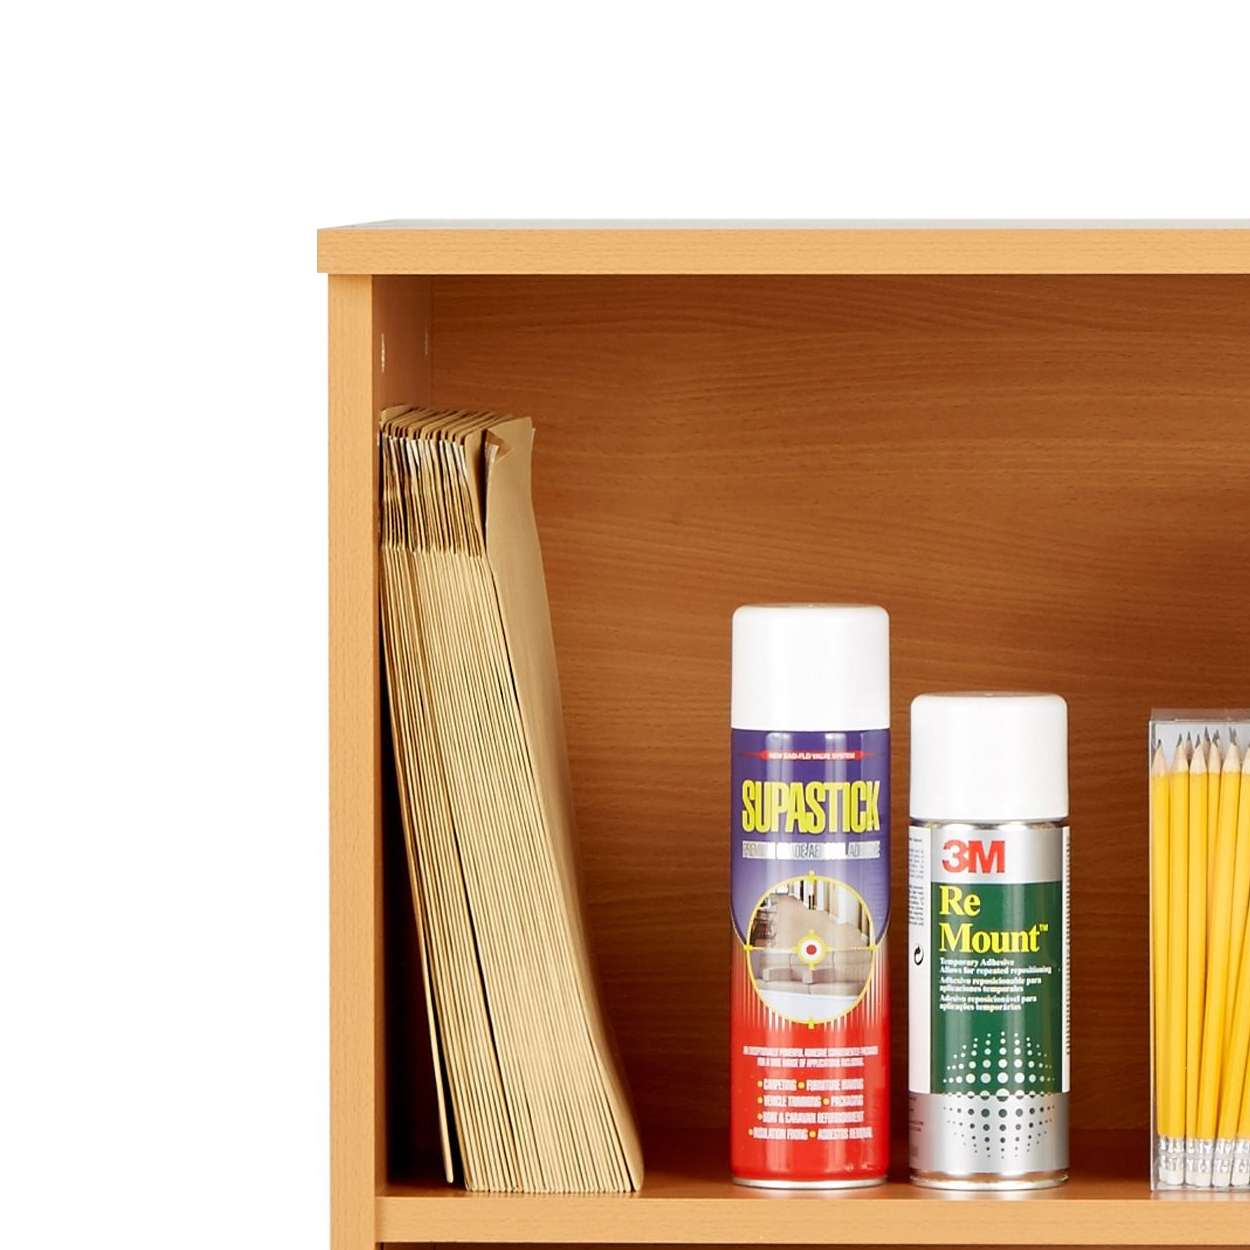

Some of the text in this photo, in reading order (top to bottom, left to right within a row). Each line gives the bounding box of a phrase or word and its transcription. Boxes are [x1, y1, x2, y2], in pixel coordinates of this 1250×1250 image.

[742, 780, 880, 834] SUPASTICK
[942, 839, 1005, 874] 3M
[939, 886, 981, 917] Re
